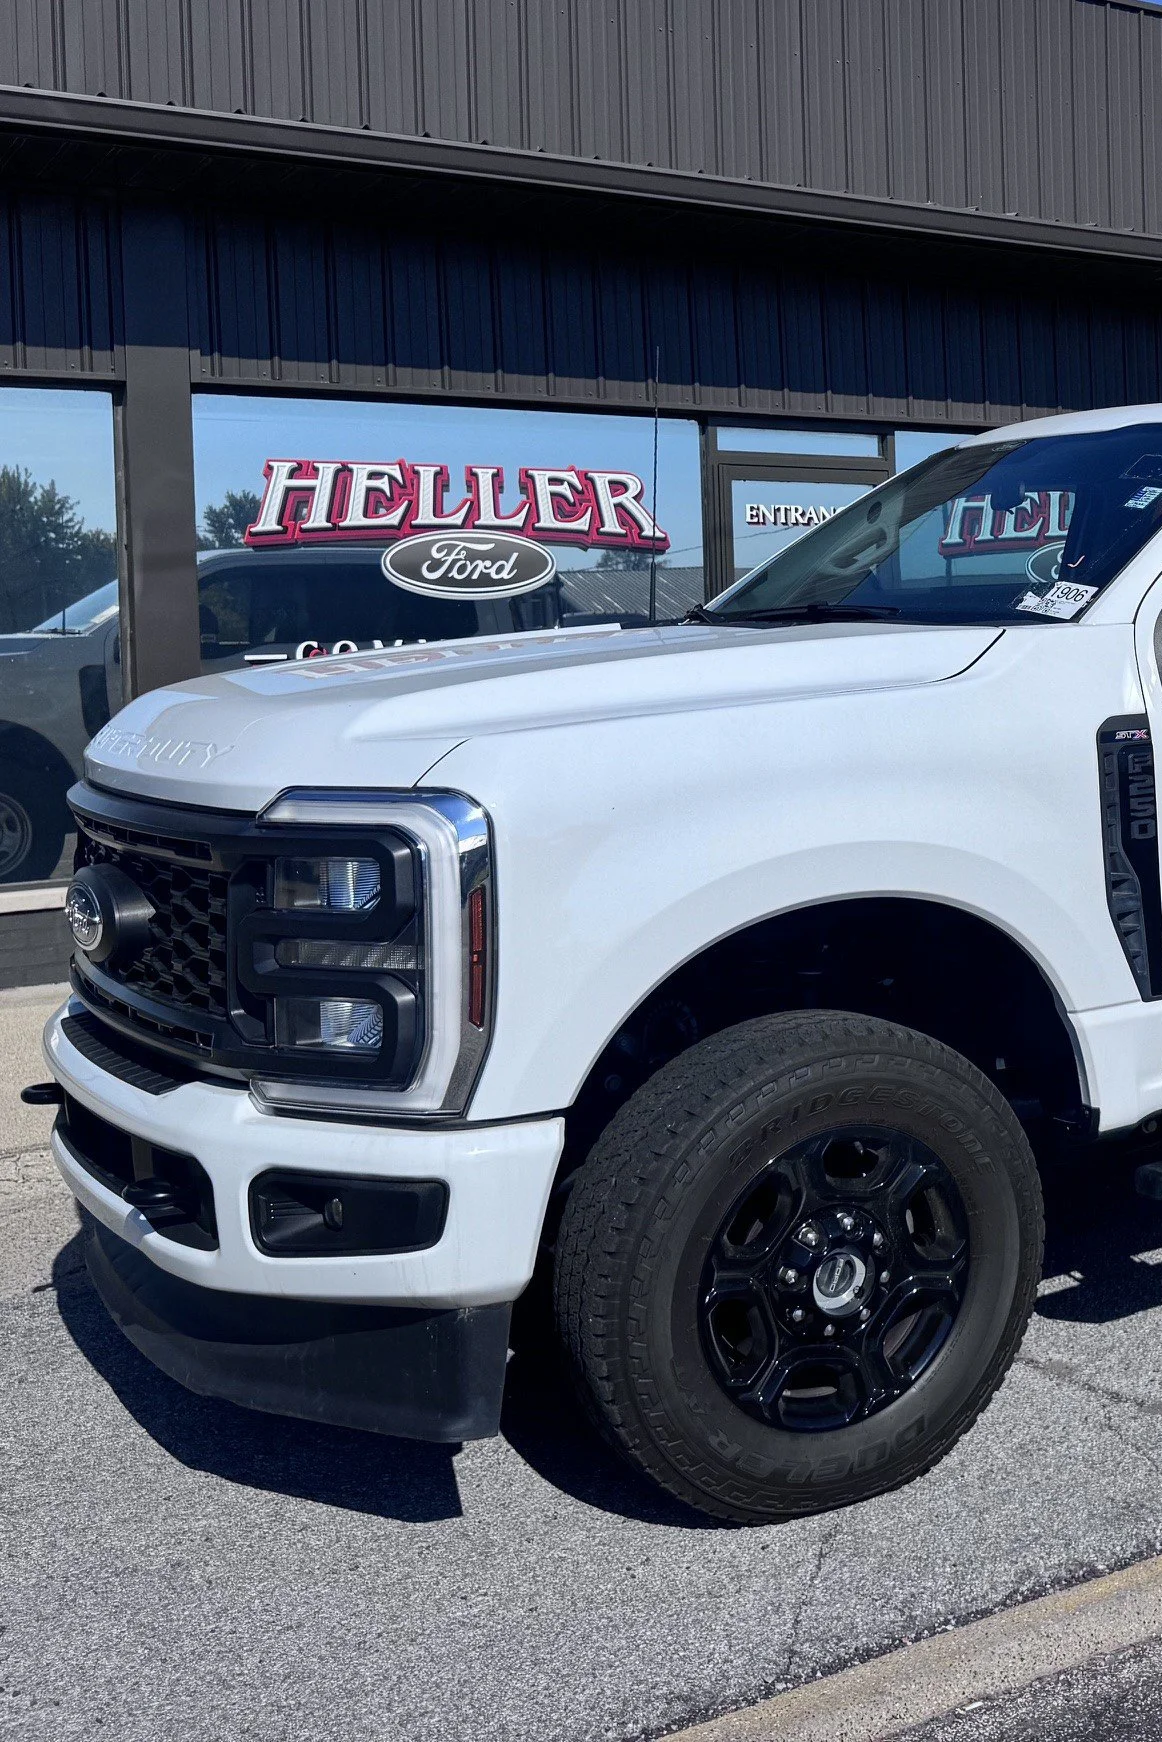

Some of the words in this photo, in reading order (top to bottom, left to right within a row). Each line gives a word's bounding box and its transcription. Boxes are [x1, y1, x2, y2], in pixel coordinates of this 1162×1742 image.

[246, 459, 668, 547] HELLER
[421, 540, 519, 581] Ford
[1051, 586, 1088, 602] 1906
[1115, 729, 1149, 740] STX
[728, 1083, 998, 1176] BRIDGESTONE
